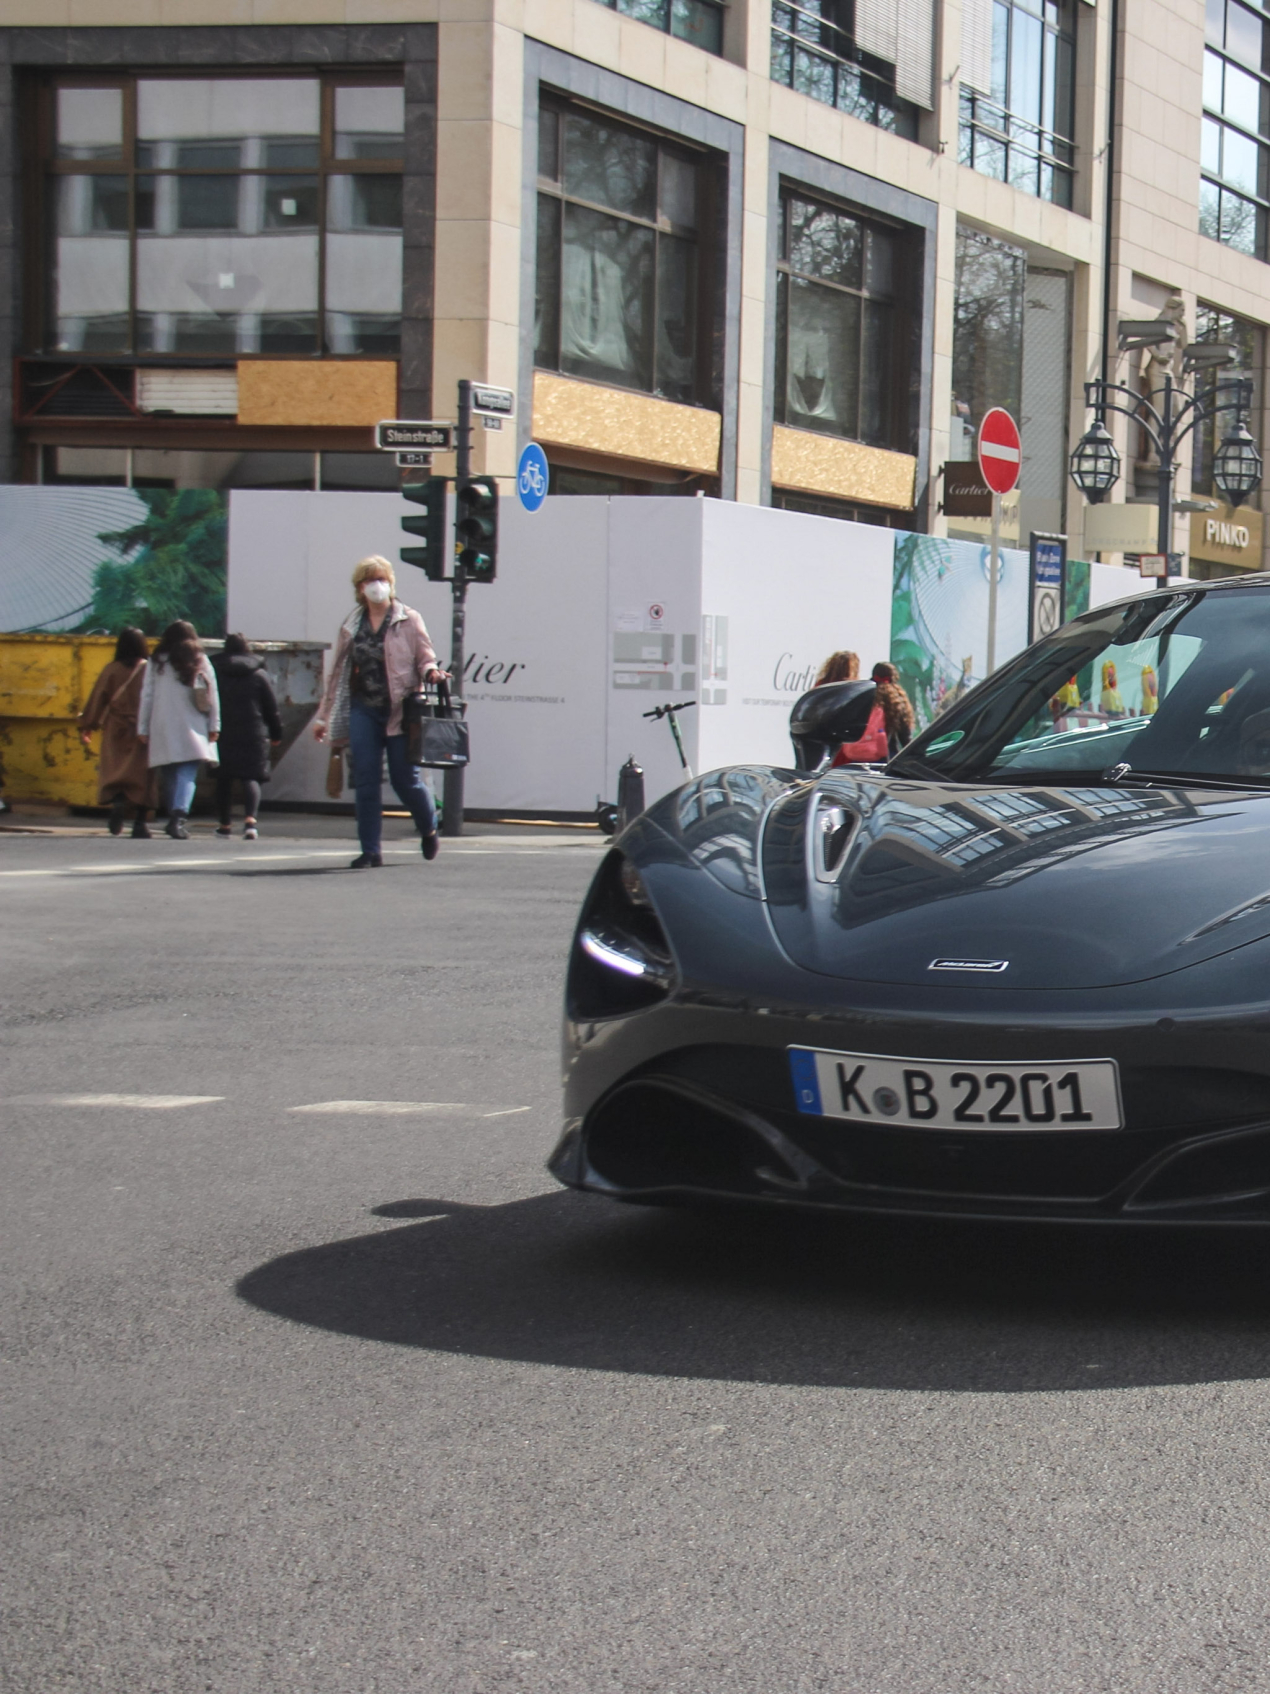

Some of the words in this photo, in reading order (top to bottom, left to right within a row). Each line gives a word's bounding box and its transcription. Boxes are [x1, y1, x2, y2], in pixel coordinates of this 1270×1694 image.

[387, 429, 444, 444] Steinstraße
[1205, 519, 1249, 548] PINKO
[773, 652, 817, 692] Carti
[491, 694, 512, 702] FLOOR
[835, 1061, 873, 1115] K
[903, 1068, 940, 1120] B
[949, 1070, 1094, 1124] 2201
